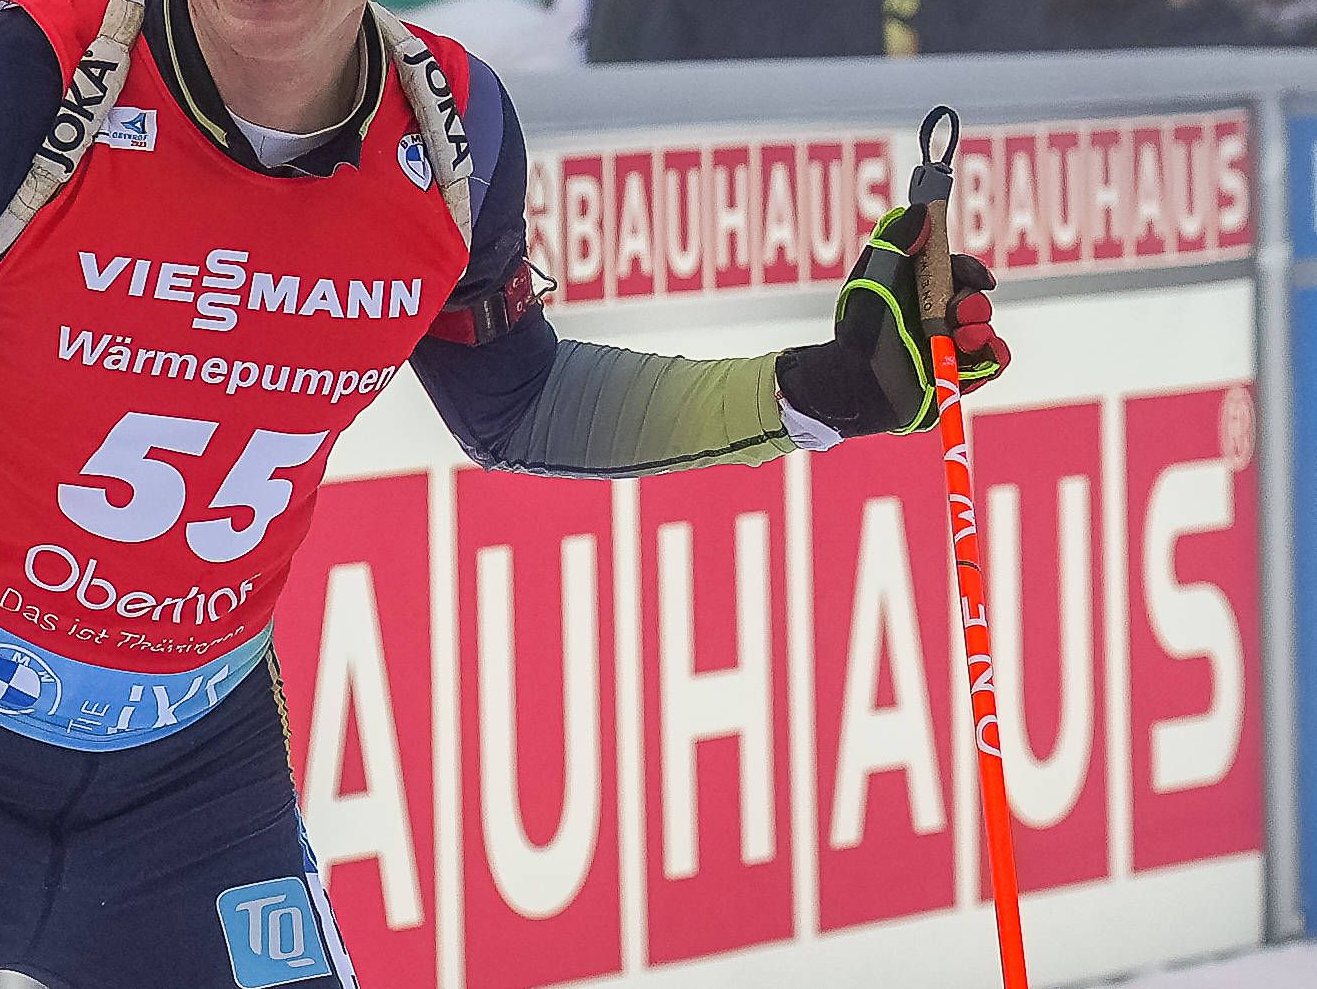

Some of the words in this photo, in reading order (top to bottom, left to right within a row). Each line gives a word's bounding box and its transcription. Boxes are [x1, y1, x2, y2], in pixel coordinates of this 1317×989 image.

[39, 60, 120, 174] JOKA
[403, 49, 471, 172] JOKA
[566, 157, 888, 281] BAUHAUS
[961, 133, 1250, 251] BAUHAUS
[78, 248, 422, 332] VIESSMANN
[57, 325, 396, 404] Wärmepumpen
[56, 411, 330, 564] 55
[0, 587, 59, 632] Das
[300, 458, 1246, 931] AUHAUS
[235, 894, 316, 968] TQ
